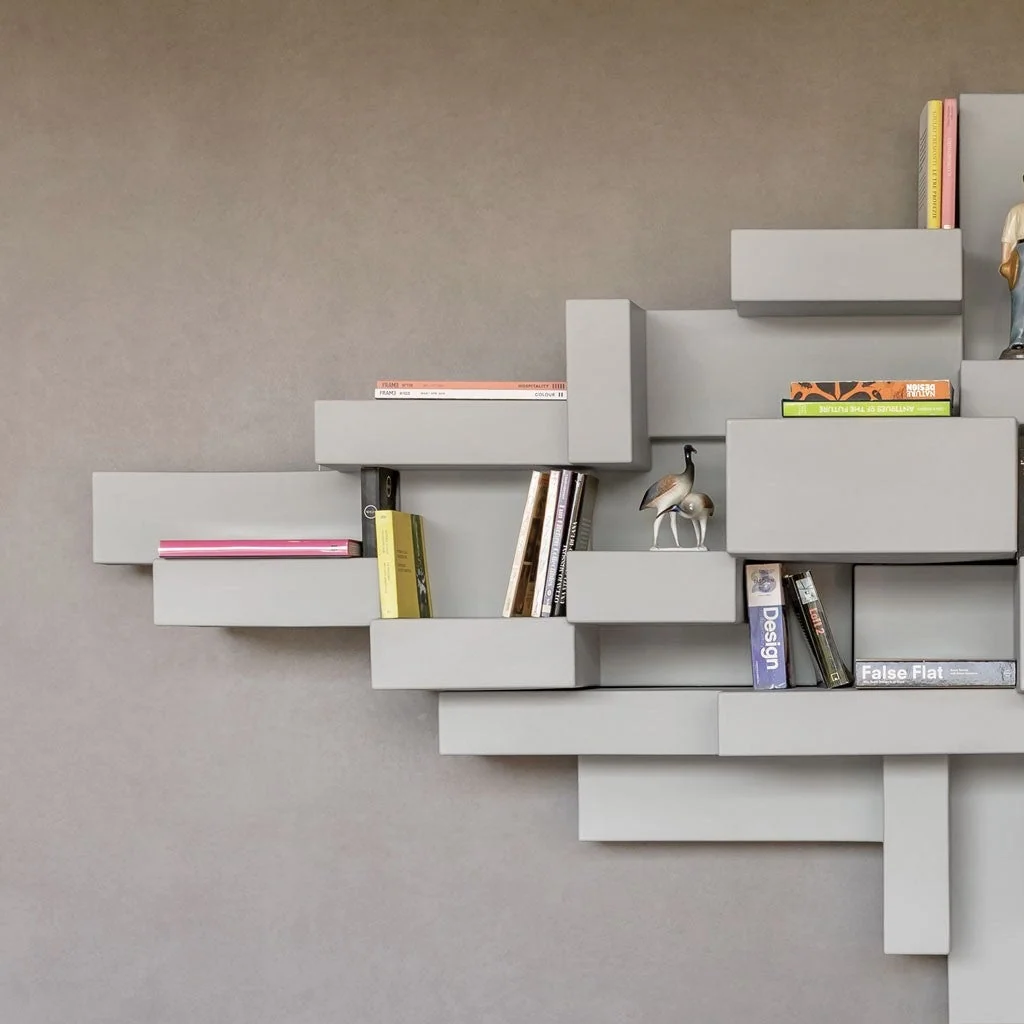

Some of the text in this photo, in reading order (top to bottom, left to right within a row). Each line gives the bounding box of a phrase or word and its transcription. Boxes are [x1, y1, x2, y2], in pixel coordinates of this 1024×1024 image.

[819, 405, 848, 413] FUTURE
[877, 405, 914, 413] ANTIQUES
[554, 574, 563, 604] OTTAVIO
[808, 607, 825, 636] Loft 2
[760, 607, 781, 670] Design
[862, 665, 907, 680] False
[912, 665, 943, 680] Flat
